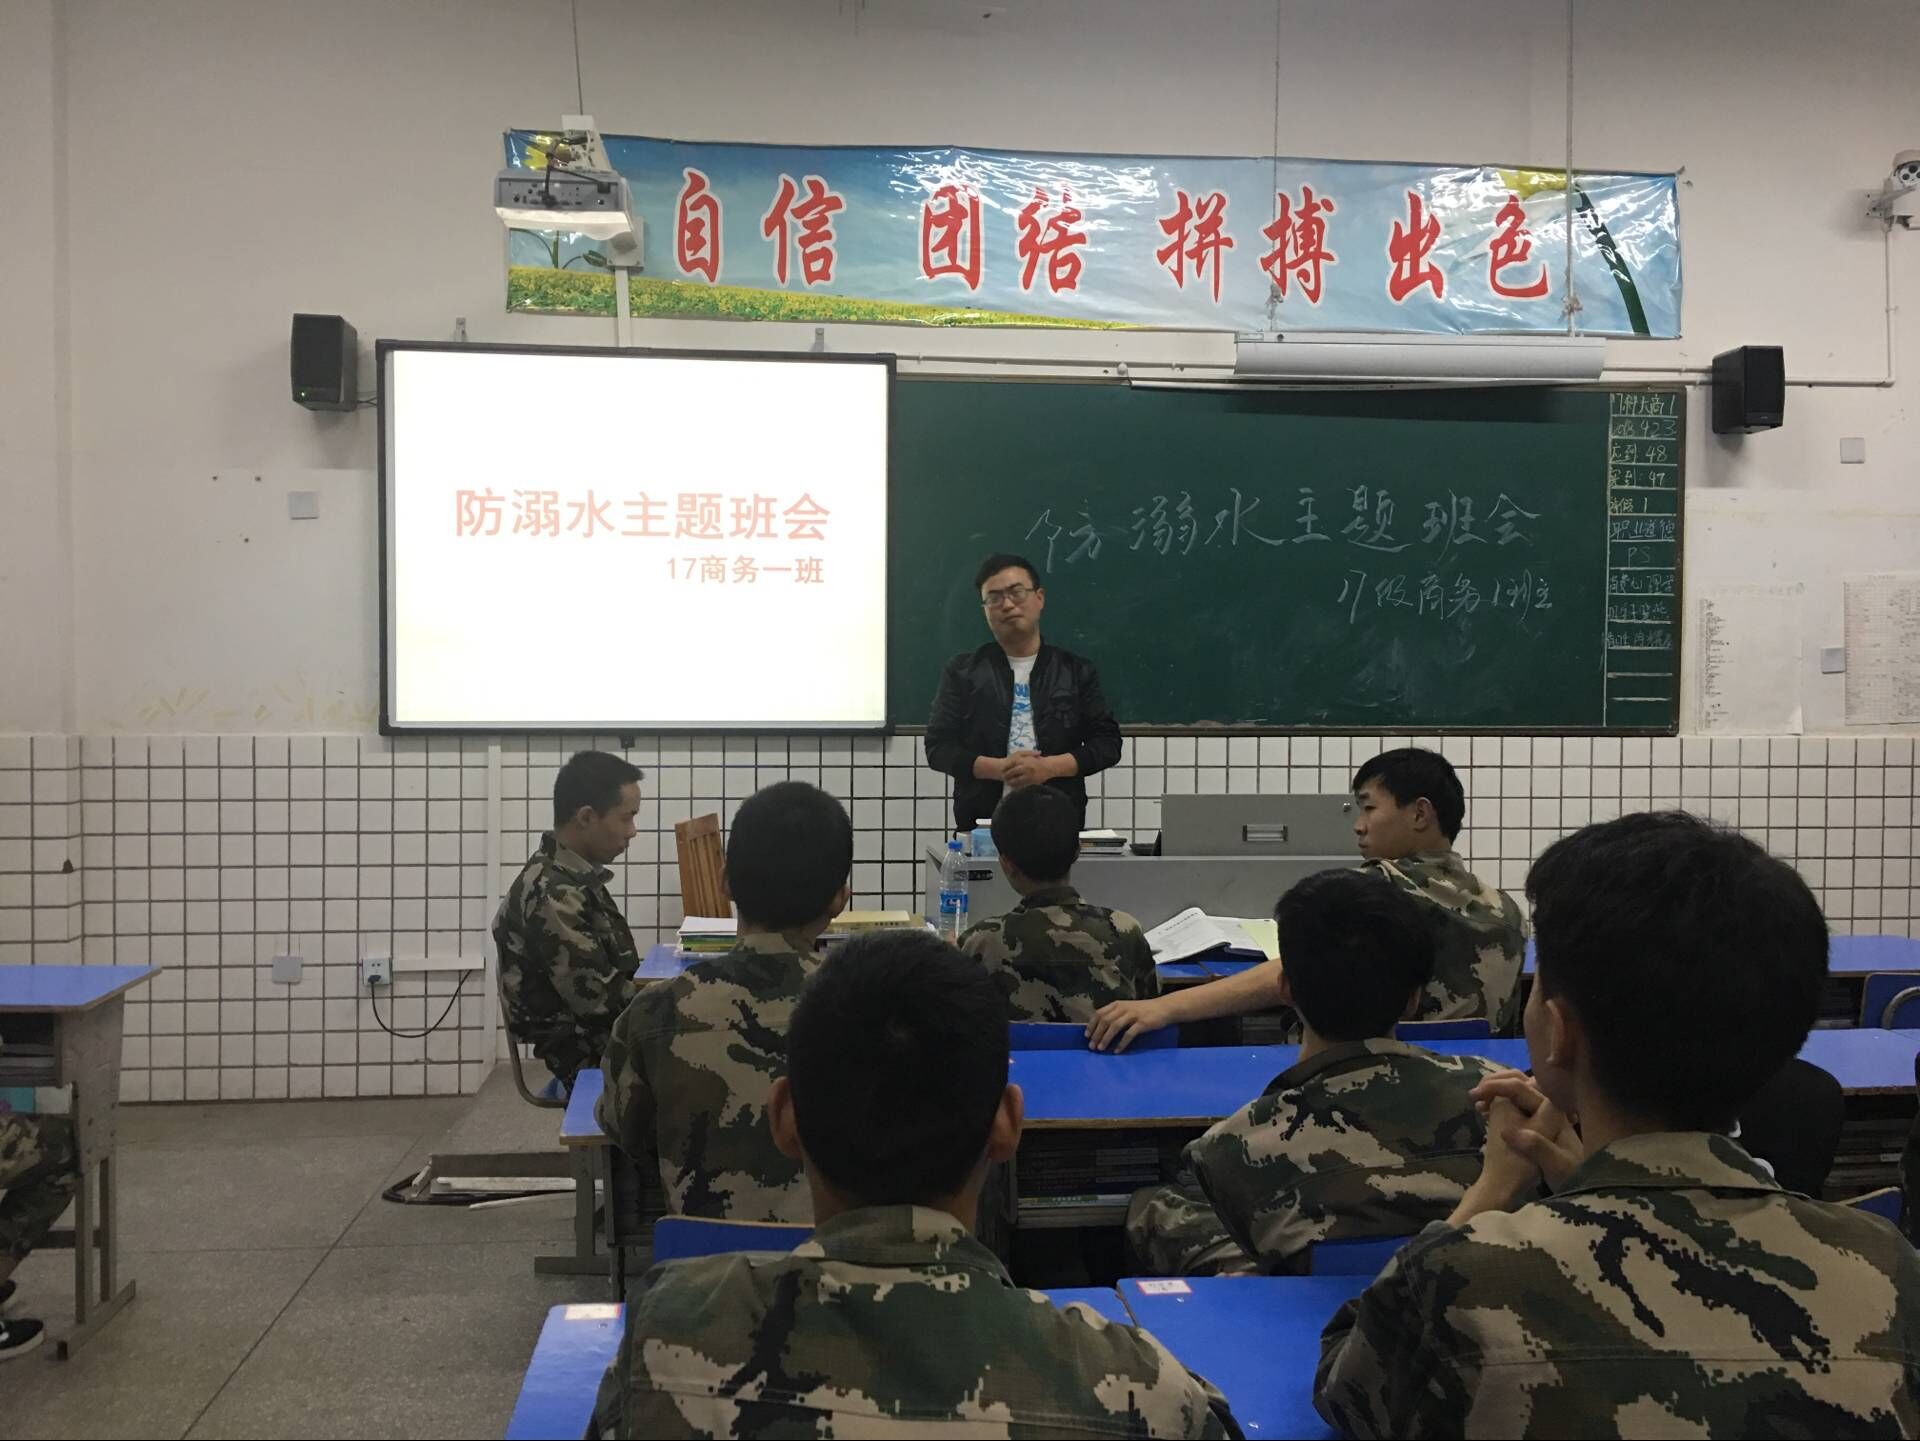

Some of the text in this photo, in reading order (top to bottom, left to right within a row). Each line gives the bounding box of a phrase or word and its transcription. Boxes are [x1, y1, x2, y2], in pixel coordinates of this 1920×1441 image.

[676, 169, 1549, 302] 自信 团结 拼搏 出色
[455, 487, 832, 542] 防溺水主题班会
[1026, 484, 1542, 573] 防溺水主题班会
[666, 554, 825, 585] 17商务一班
